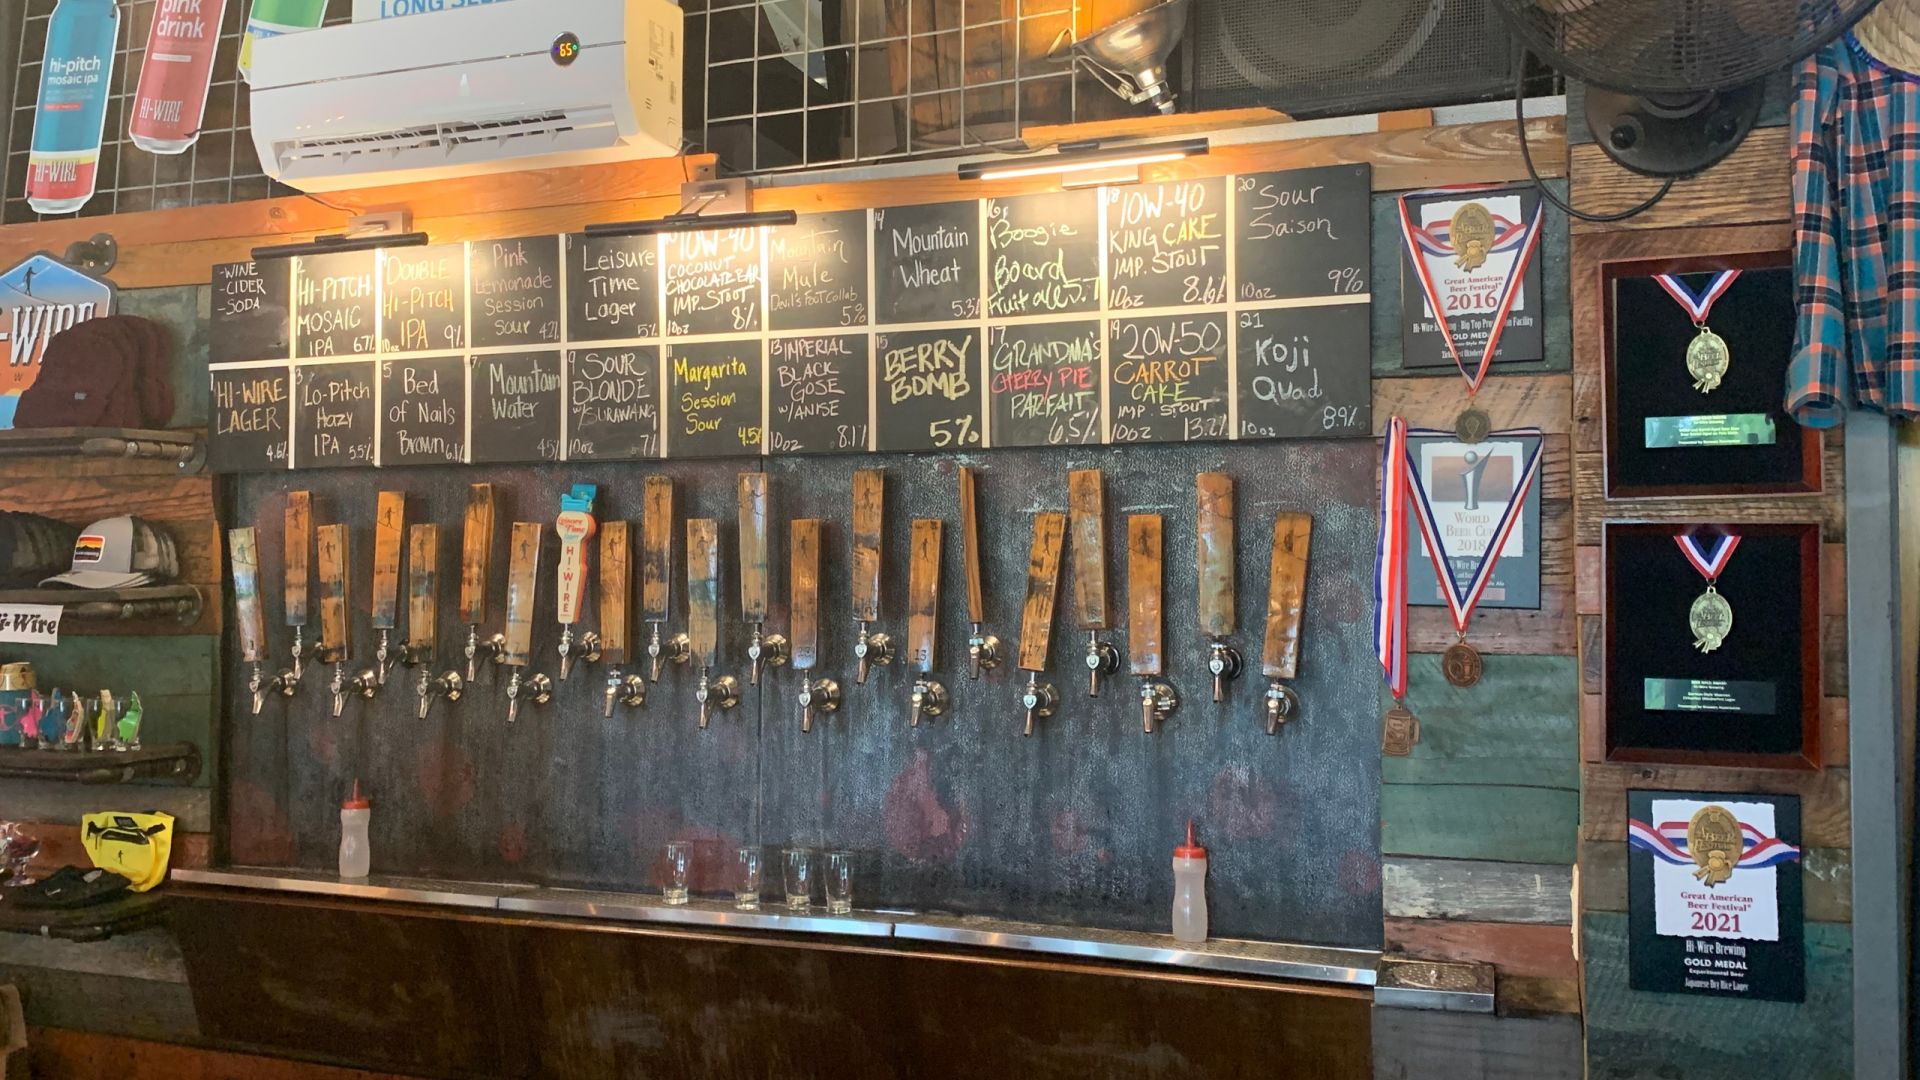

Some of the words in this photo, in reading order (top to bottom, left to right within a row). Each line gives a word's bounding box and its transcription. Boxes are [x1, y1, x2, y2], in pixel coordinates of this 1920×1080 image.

[380, 0, 445, 19] LONG
[156, 16, 204, 39] drink
[559, 42, 573, 57] 65
[49, 56, 101, 74] hi-pitch
[47, 74, 83, 85] mosaic
[83, 73, 99, 85] ipa
[140, 97, 184, 122] HI-WIRE
[35, 159, 79, 182] HI-WIRE
[1237, 177, 1256, 192] 20
[1252, 184, 1325, 210] Sour
[1120, 183, 1205, 228] 10W-40
[874, 210, 885, 231] 14
[1247, 213, 1340, 240] Saison
[770, 229, 849, 263] Mountain
[892, 226, 969, 257] Mountain
[990, 218, 1078, 250] Boogie
[1109, 228, 1160, 258] KING
[1162, 213, 1222, 246] CAKE
[493, 241, 529, 269] Pink
[583, 245, 656, 272] Leisure
[667, 254, 737, 280] COCONUT
[1151, 245, 1220, 275] STOUT
[386, 255, 451, 286] DOUBLE
[475, 267, 553, 296] Lemonade
[665, 271, 736, 296] CHOCOLATE
[783, 262, 834, 291] Mule
[899, 257, 962, 289] Wheat
[994, 248, 1069, 294] Board
[1327, 267, 1364, 294] 9%
[1444, 277, 1465, 286] Great
[1467, 275, 1504, 284] American
[298, 273, 371, 307] HI-PITCH
[588, 275, 641, 298] Time
[701, 284, 755, 310] STOUT
[825, 285, 858, 302] Collab
[1449, 285, 1467, 293] Beer
[382, 286, 455, 320] HI-PITCH
[484, 296, 544, 317] Session
[584, 301, 637, 325] Lager
[1446, 289, 1498, 311] 2016
[296, 305, 362, 337] MOSAIC
[840, 303, 867, 327] 5%
[1240, 312, 1265, 330] 21
[400, 317, 429, 349] IPA
[443, 324, 465, 348] 9%
[637, 323, 658, 337] 5%
[875, 335, 889, 350] 15
[1110, 320, 1120, 341] 19
[1122, 321, 1222, 360] 20W-50
[309, 336, 335, 358] IPA
[783, 337, 853, 363] IMPERIAL
[884, 335, 972, 383] BERRY
[1255, 333, 1311, 374] Koji
[296, 368, 304, 385] 3
[382, 362, 393, 379] 5
[489, 359, 562, 397] Mountain
[581, 352, 647, 381] SOUR
[673, 356, 748, 392] Margarita
[777, 361, 840, 388] BLACK
[1113, 355, 1217, 387] CARROT
[216, 377, 288, 409] HI-WIRE
[404, 367, 440, 395] Bed
[572, 377, 651, 407] BLONDE
[790, 377, 846, 404] GOSE
[891, 371, 971, 405] BOMB
[990, 368, 1053, 405] CHERRY
[1058, 366, 1094, 389] PIE
[1131, 381, 1204, 405] CAKE
[1252, 367, 1323, 407] Quad
[417, 397, 456, 426] Nails
[490, 395, 540, 420] Water
[680, 391, 737, 413] Session
[1010, 390, 1096, 420] PARFAIT
[1159, 398, 1221, 419] STOUT
[216, 406, 282, 436] LAGER
[316, 406, 354, 430] Hazy
[685, 412, 723, 436] Sour
[1049, 406, 1099, 445] 6.5%
[1322, 404, 1358, 431] 8.9%
[396, 429, 445, 457] Brown
[929, 414, 980, 448] 5%
[265, 440, 290, 462] 4.6%
[313, 432, 341, 458] IPA
[640, 433, 658, 457] 7%
[1456, 538, 1486, 552] 2018
[562, 546, 575, 613] HI-WIRE
[1680, 891, 1706, 901] Great
[1709, 893, 1754, 903] American
[1687, 901, 1709, 910] Beer
[1691, 912, 1742, 933] 2021
[1715, 942, 1746, 958] Brewing
[1683, 957, 1712, 967] GOLD
[1714, 959, 1748, 970] MEDAL
